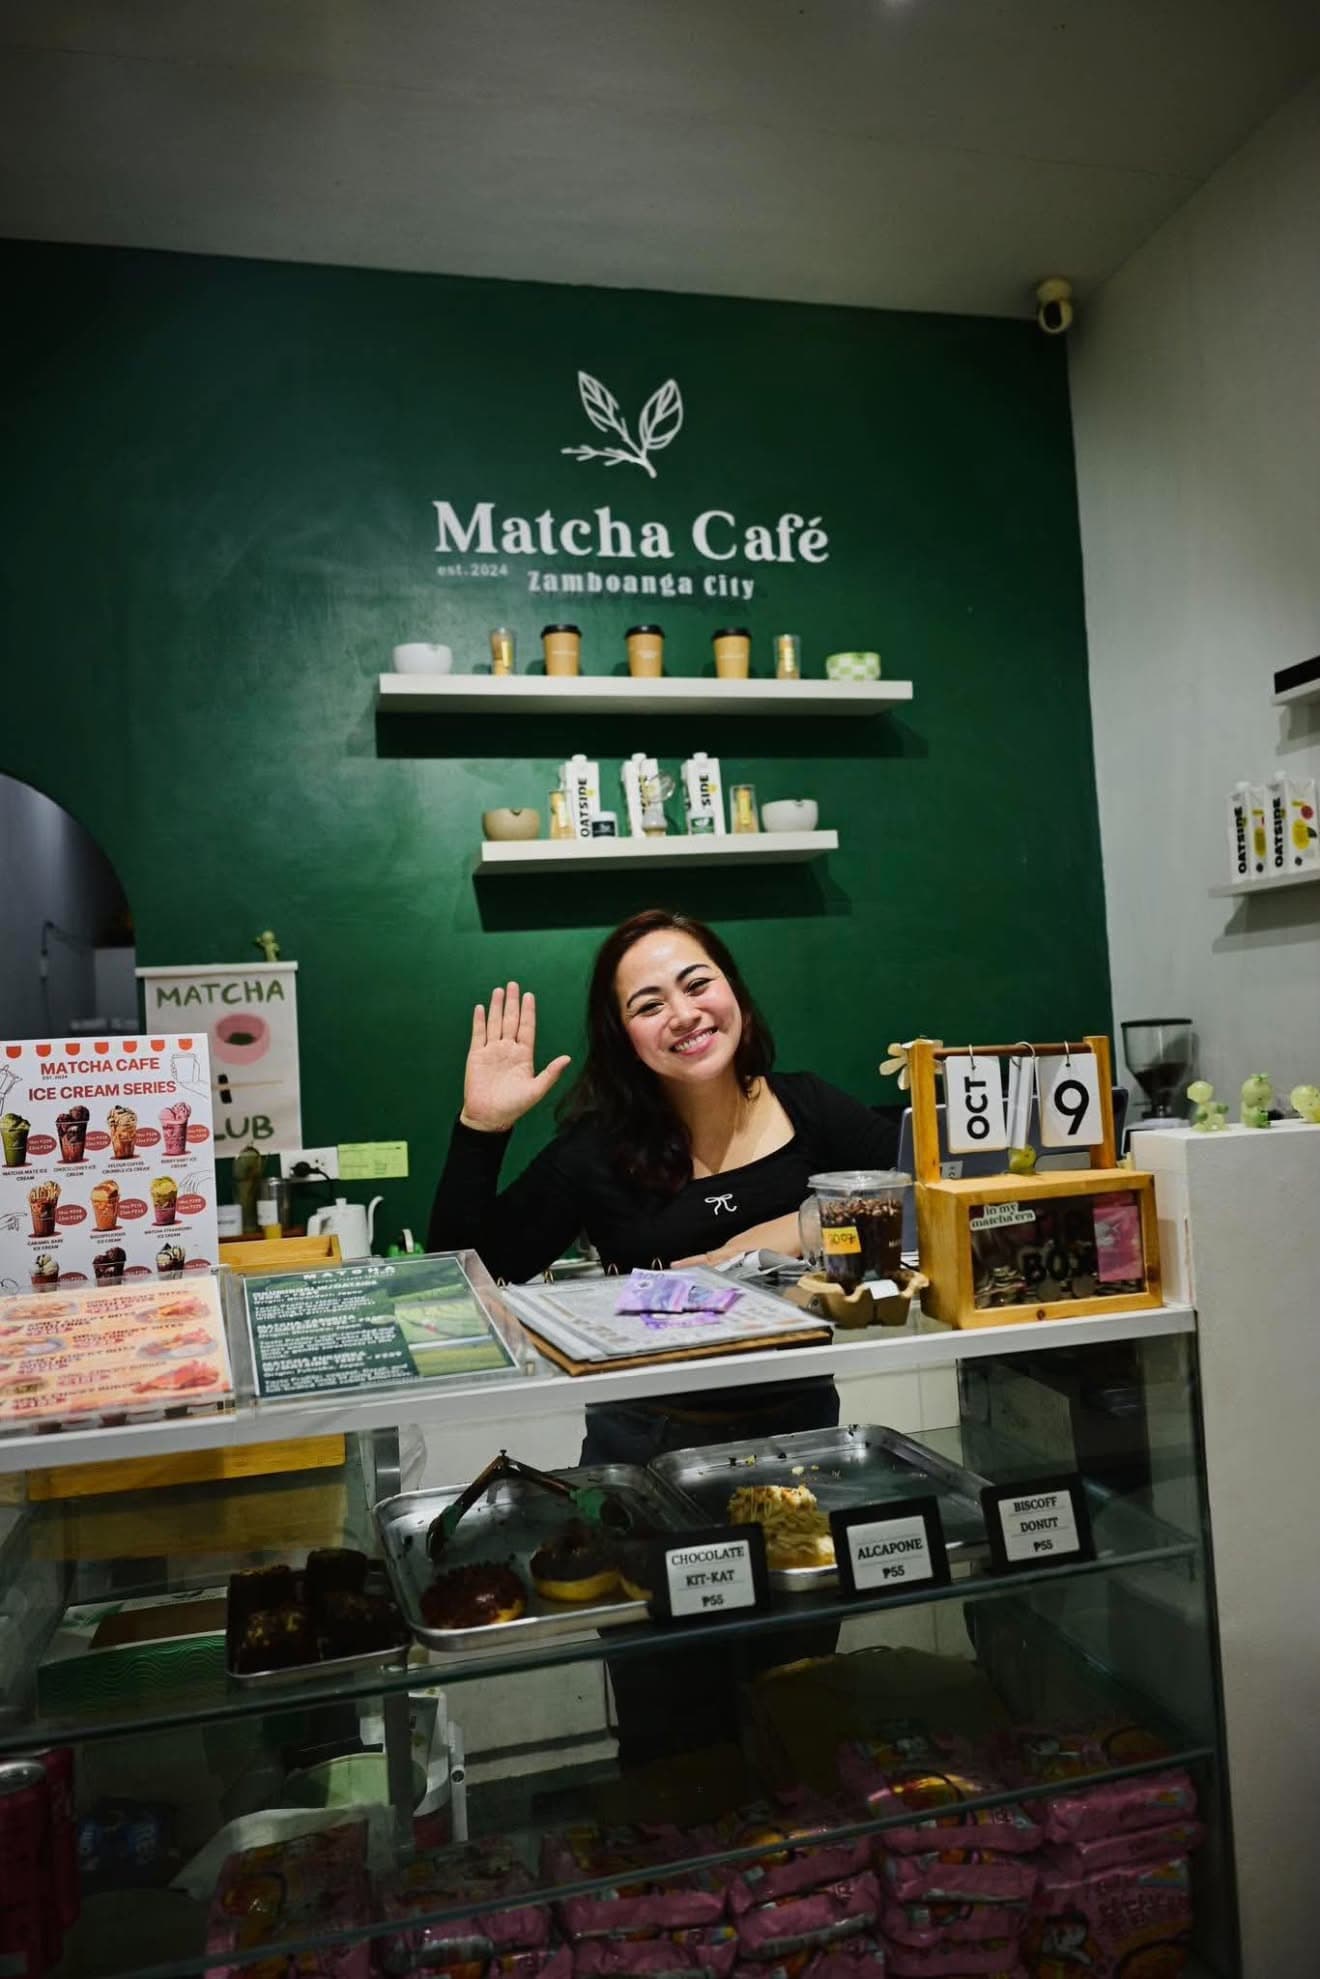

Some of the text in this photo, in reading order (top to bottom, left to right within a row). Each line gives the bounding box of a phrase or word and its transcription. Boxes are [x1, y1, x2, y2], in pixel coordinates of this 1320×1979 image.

[433, 500, 830, 564] Matcha Café
[437, 563, 509, 577] est.2024
[528, 570, 754, 600] Zamboanga City
[699, 775, 712, 806] SIDE
[578, 776, 591, 838] OATSIDE
[1235, 806, 1246, 874] OATSIDE
[1273, 797, 1284, 868] OATSIDE
[156, 979, 285, 1008] MATCHA
[40, 1057, 160, 1076] MATCHA CAFE
[29, 1080, 177, 1102] ICE CREAM SERIES
[964, 1076, 990, 1140] OCT
[1054, 1079, 1090, 1136] 9
[1013, 1496, 1057, 1512] BISCOFF
[1020, 1517, 1058, 1533] DONUT
[671, 1546, 745, 1566] CHOCOLATE
[858, 1537, 923, 1560] ALCAPONE
[685, 1569, 735, 1587] KIT-KAT
